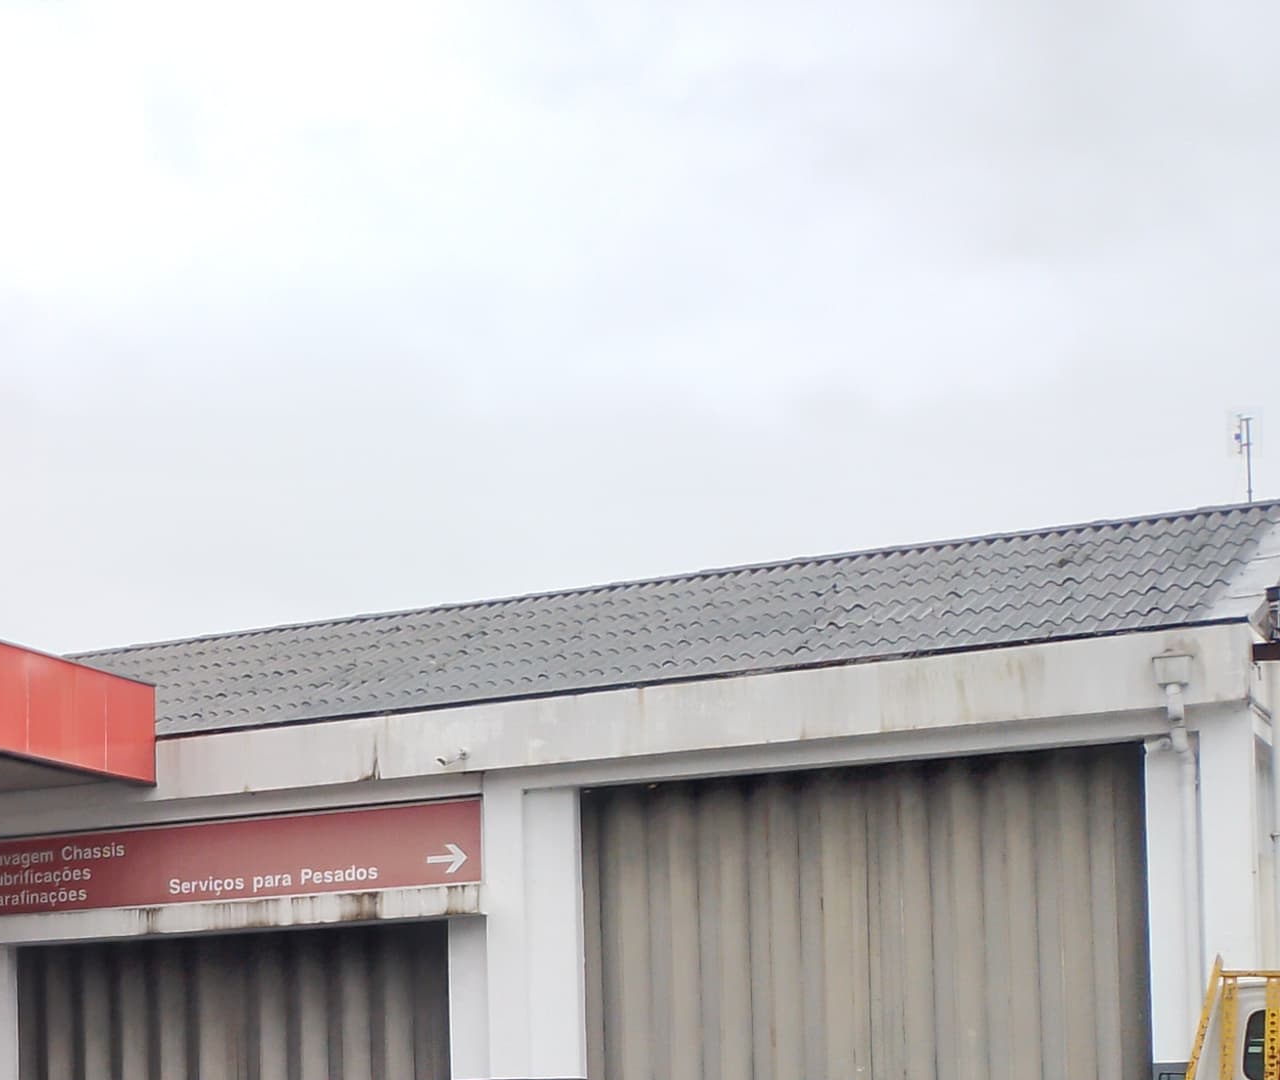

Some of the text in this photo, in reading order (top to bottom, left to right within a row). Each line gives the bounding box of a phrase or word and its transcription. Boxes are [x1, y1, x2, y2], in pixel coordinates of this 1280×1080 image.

[61, 843, 125, 862] Chassis
[168, 865, 379, 896] Serviços para Pesados
